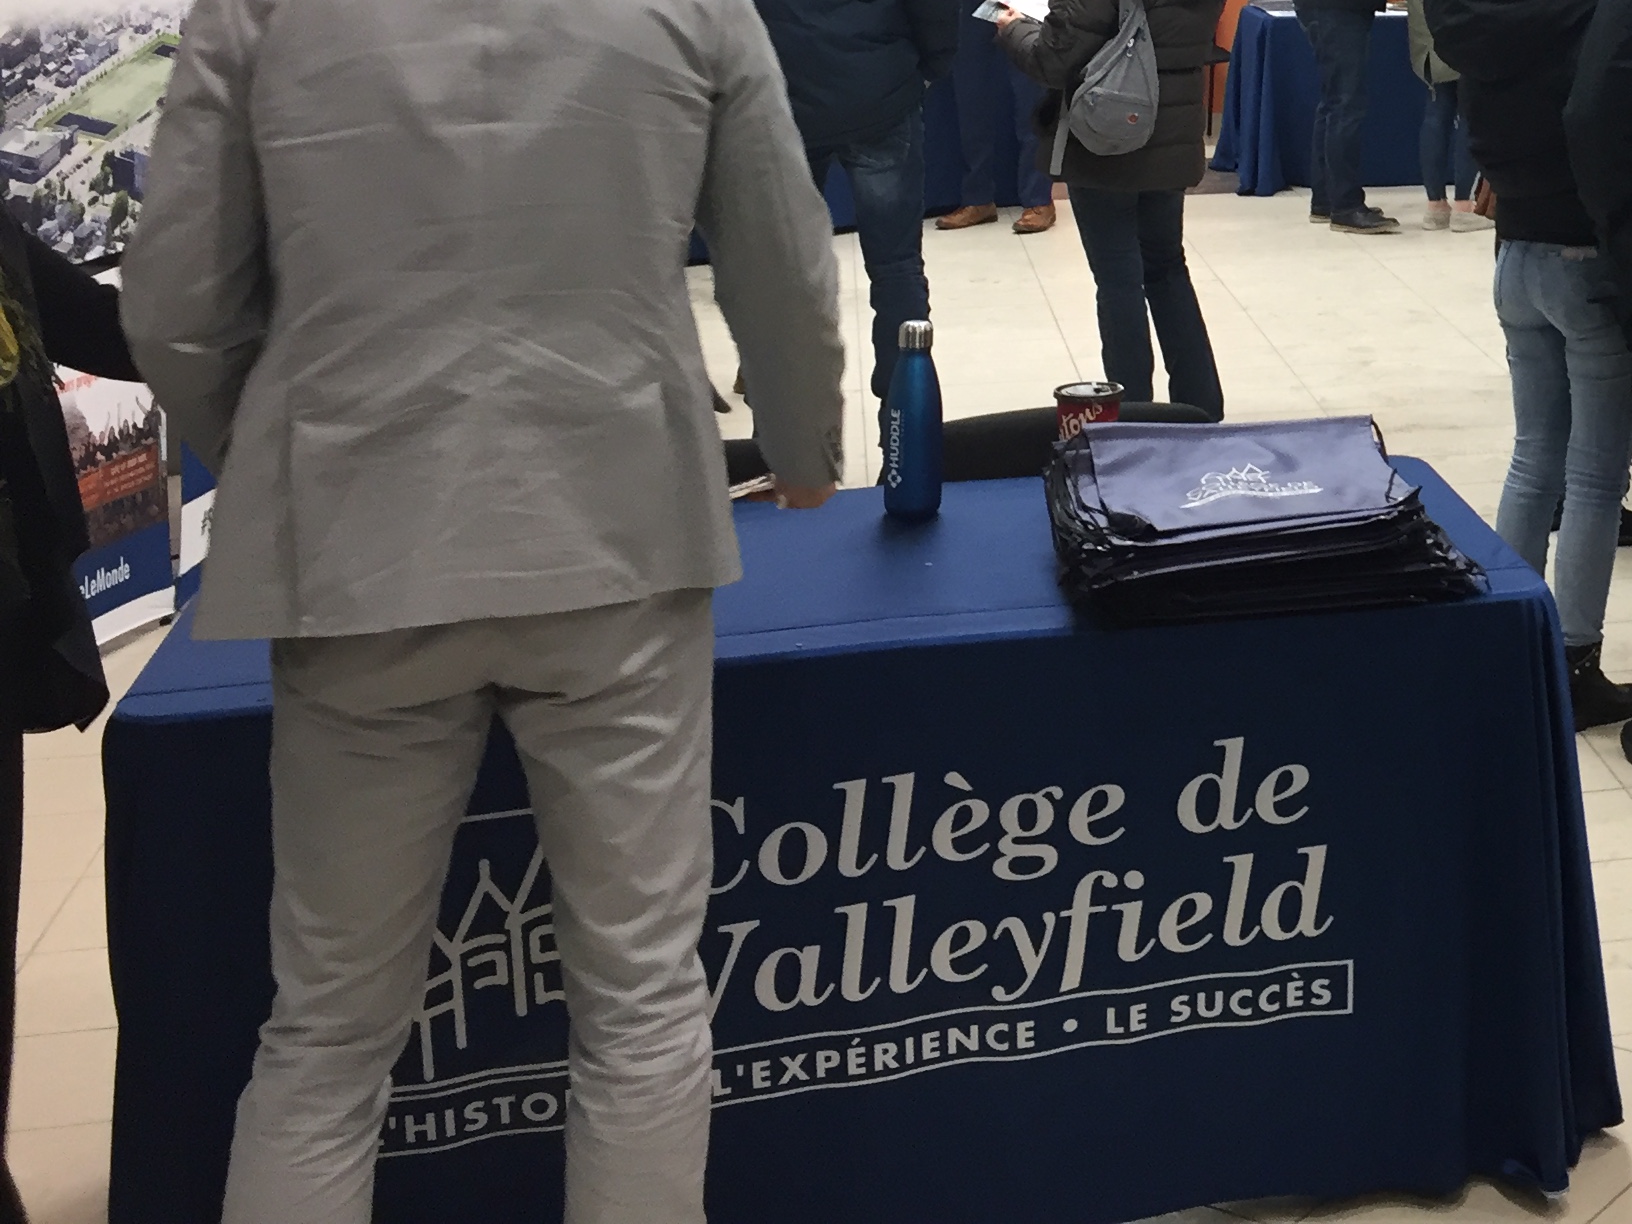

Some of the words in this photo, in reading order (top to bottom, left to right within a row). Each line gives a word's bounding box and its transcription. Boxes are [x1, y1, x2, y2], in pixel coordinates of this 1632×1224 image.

[889, 408, 901, 469] HUDDLE
[1176, 736, 1311, 834] de
[711, 1020, 1036, 1097] L'EXPÉRIENCE
[1106, 1003, 1148, 1035] LE
[1169, 971, 1333, 1024] SUCCÈS
